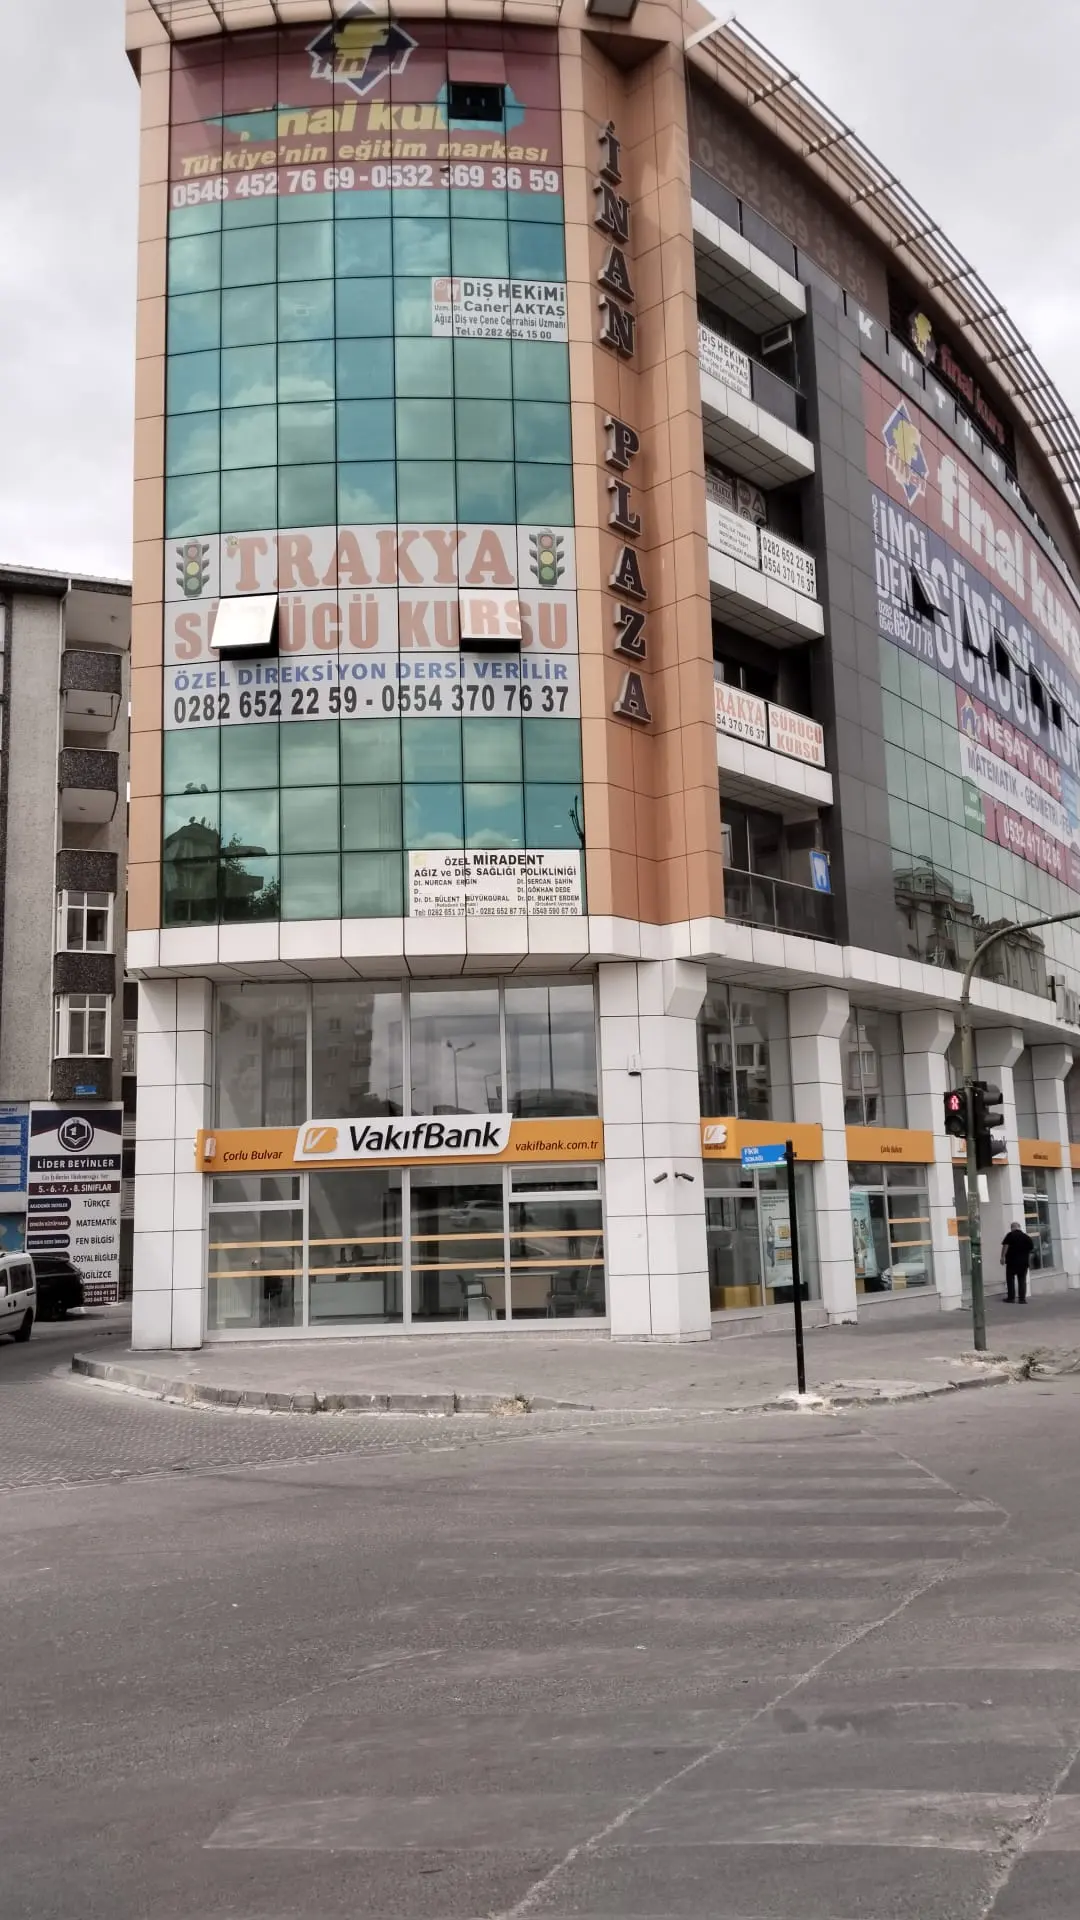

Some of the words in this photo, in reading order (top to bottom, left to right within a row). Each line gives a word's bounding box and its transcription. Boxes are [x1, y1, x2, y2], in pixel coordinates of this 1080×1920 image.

[181, 146, 327, 177] Türkiye'nin
[338, 138, 433, 162] eğitim
[437, 139, 548, 163] markası
[172, 177, 229, 208] 0546
[235, 172, 278, 198] 452
[287, 170, 316, 193] 76
[323, 167, 354, 190] 69
[371, 165, 433, 188] 0532
[440, 166, 485, 188] 369
[492, 167, 522, 190] 36
[529, 169, 559, 193] 59
[593, 120, 637, 359] İNAN
[464, 301, 509, 313] Caner
[514, 303, 566, 319] AKTAŞ
[485, 328, 503, 337] 282
[226, 529, 515, 592] TRAKYA
[762, 536, 780, 558] 0282
[782, 547, 795, 565] 652
[795, 555, 804, 571] 22
[805, 560, 814, 577] 59
[604, 415, 653, 724] PLAZA
[763, 555, 781, 577] 0554
[782, 565, 795, 584] 370
[806, 578, 815, 593] 37
[174, 593, 379, 661] SÜCÜ
[399, 597, 568, 650] KURSU
[174, 669, 230, 691] ÖZEL
[238, 659, 386, 686] DİREKSİYON
[395, 658, 466, 680] DERSİ
[474, 659, 568, 682] VERİLİR
[173, 692, 231, 724] 0282
[239, 690, 282, 718] 652
[291, 687, 319, 715] 22
[328, 686, 357, 714] 59
[382, 684, 443, 713] 0554
[452, 684, 495, 713] 370
[503, 685, 533, 713] 76
[541, 685, 569, 713] 37
[728, 718, 743, 733] 370
[414, 867, 438, 878] AĞIZ
[441, 869, 451, 877] ve
[476, 866, 516, 877] SAĞLIĞI
[520, 865, 577, 877] POLİKLİNİĞİ
[444, 856, 470, 866] ÖZEL
[473, 852, 545, 866] MİRADENT
[348, 1120, 502, 1152] VakıfBank
[37, 1158, 66, 1169] LİDER
[68, 1156, 115, 1168] BEYİNLER
[223, 1150, 248, 1162] Çorlu
[250, 1150, 283, 1160] Bulvar
[83, 1198, 111, 1209] TÜRKÇE
[76, 1217, 118, 1227] MATEMATİK
[76, 1237, 89, 1245] FEN
[72, 1254, 94, 1263] SOSYAL
